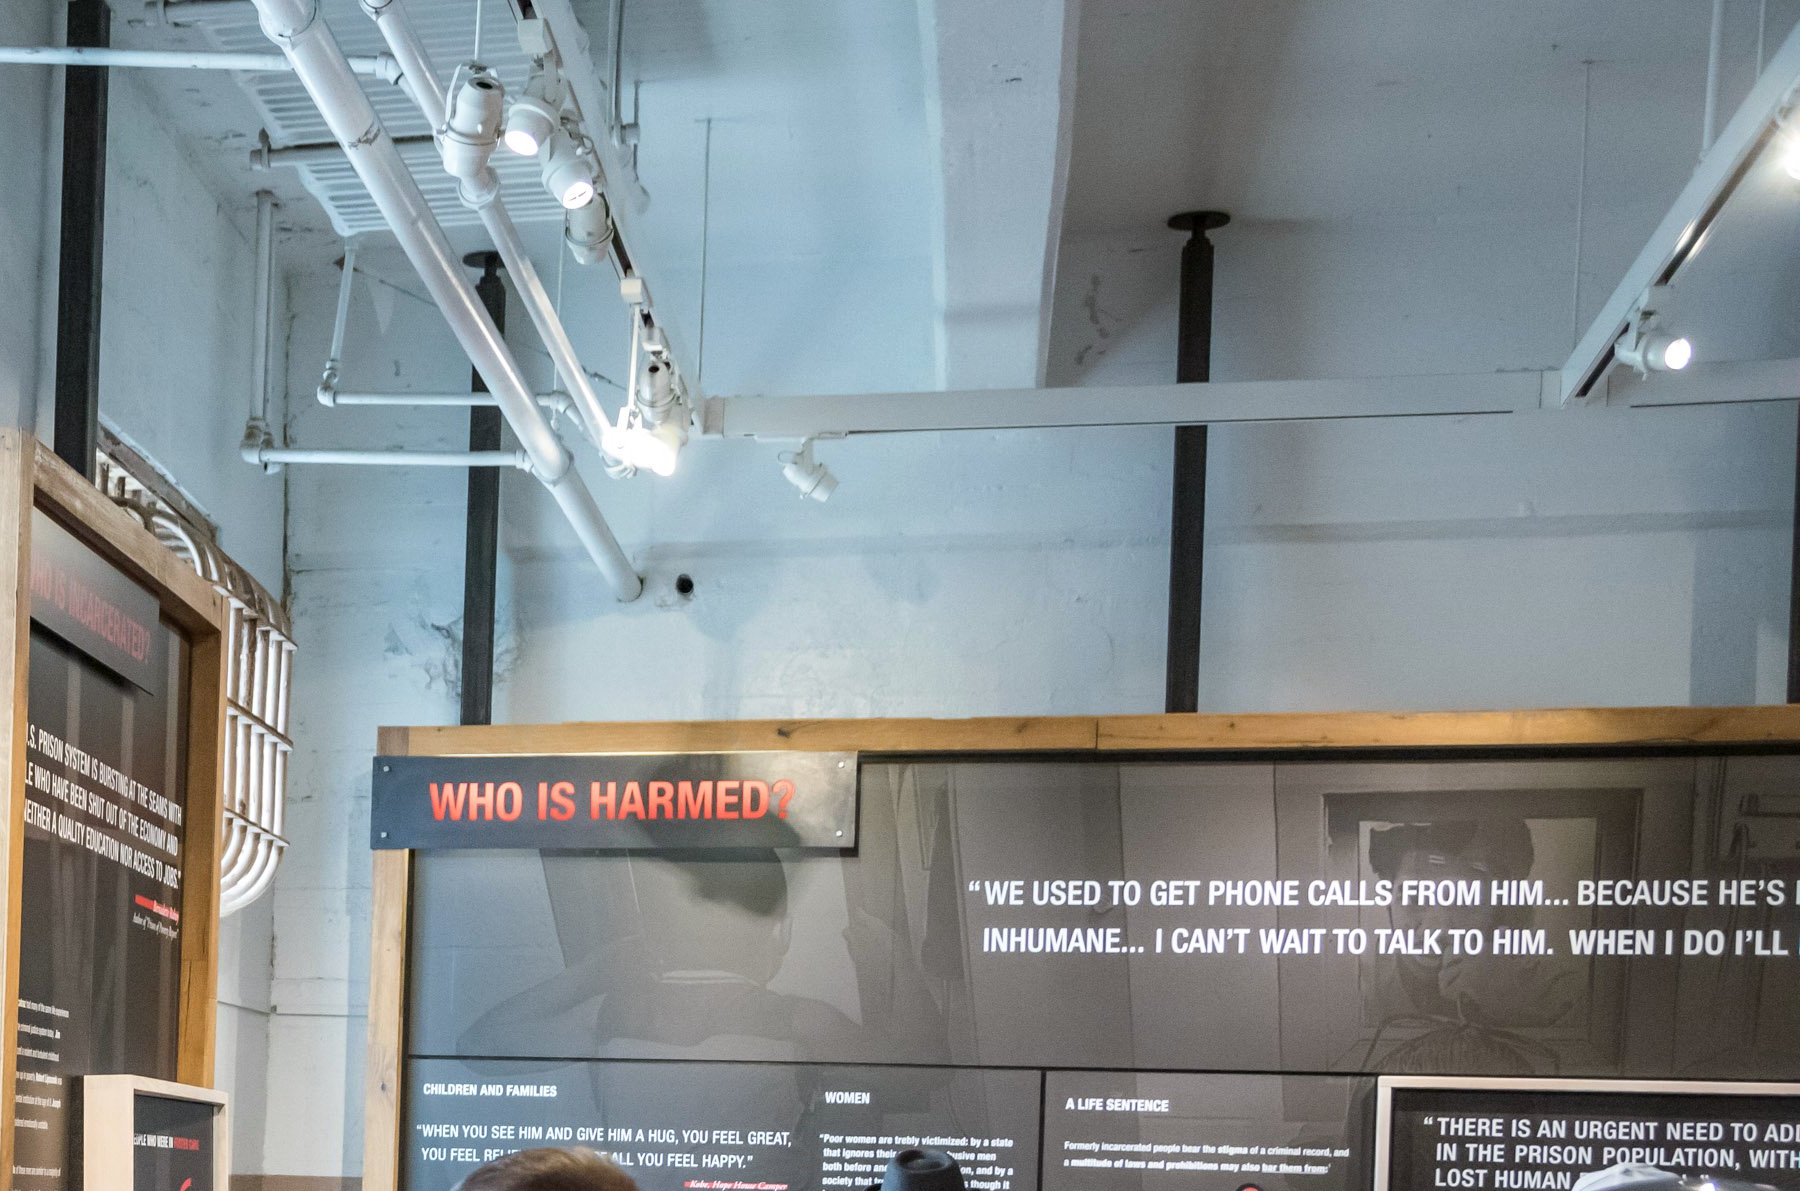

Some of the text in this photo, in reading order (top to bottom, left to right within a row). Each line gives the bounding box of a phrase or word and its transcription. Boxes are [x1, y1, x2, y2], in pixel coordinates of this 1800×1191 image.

[38, 729, 63, 762] PRISON
[64, 744, 90, 776] SYSTEM
[91, 757, 98, 780] IS
[99, 763, 128, 797] BURSTING
[128, 780, 136, 800] AT
[137, 783, 148, 808] THE
[149, 790, 168, 818] SEAMS
[168, 801, 182, 825] WITH
[429, 779, 796, 821] WHO IS HARMED?
[58, 815, 85, 845] QUALITY
[86, 827, 119, 861] EDUCATION
[120, 843, 132, 867] NOR
[133, 850, 154, 878] ACCESS
[156, 860, 162, 882] TO
[1033, 881, 1101, 905] USED
[1108, 880, 1141, 905] TO
[1150, 880, 1200, 905] GET
[1209, 880, 1299, 906] PHONE
[1308, 880, 1392, 906] CALLS
[1402, 880, 1480, 905] FROM
[1491, 880, 1568, 905] HIM...
[1578, 880, 1708, 905] BECAUSE
[1719, 880, 1784, 905] HE’S
[983, 928, 1788, 955] INHUMANE... I CAN’T WAIT TO TALK TO HIM. WHEN I DO I’LL
[423, 1083, 557, 1097] CHILDREN AND FAMILIES
[825, 1091, 870, 1104] WOMEN
[1065, 1098, 1169, 1112] A LIFE SENTENCE
[462, 1125, 487, 1138] YOU
[491, 1125, 515, 1139] SEE
[519, 1126, 542, 1139] HIM
[545, 1127, 572, 1140] AND
[577, 1127, 604, 1141] GIVE
[608, 1128, 632, 1142] HIM
[635, 1129, 644, 1142] A
[648, 1129, 678, 1144] HUG,
[682, 1130, 708, 1143] YOU
[712, 1130, 744, 1144] FEEL
[748, 1131, 791, 1147] GREAT,
[1512, 1119, 1530, 1137] IS
[1537, 1120, 1566, 1138] AN
[1574, 1121, 1658, 1140] URGENT
[1667, 1123, 1723, 1141] NEED
[1730, 1123, 1757, 1141] TO
[422, 1147, 446, 1161] YOU
[450, 1148, 480, 1162] FEEL
[637, 1153, 663, 1166] YOU
[667, 1153, 698, 1167] FEEL
[1436, 1143, 1456, 1161] IN
[1465, 1144, 1505, 1162] THE
[1515, 1145, 1592, 1164] PRISON
[1603, 1147, 1740, 1169] POPULATION,
[1435, 1168, 1572, 1189] LOST HUMAN
